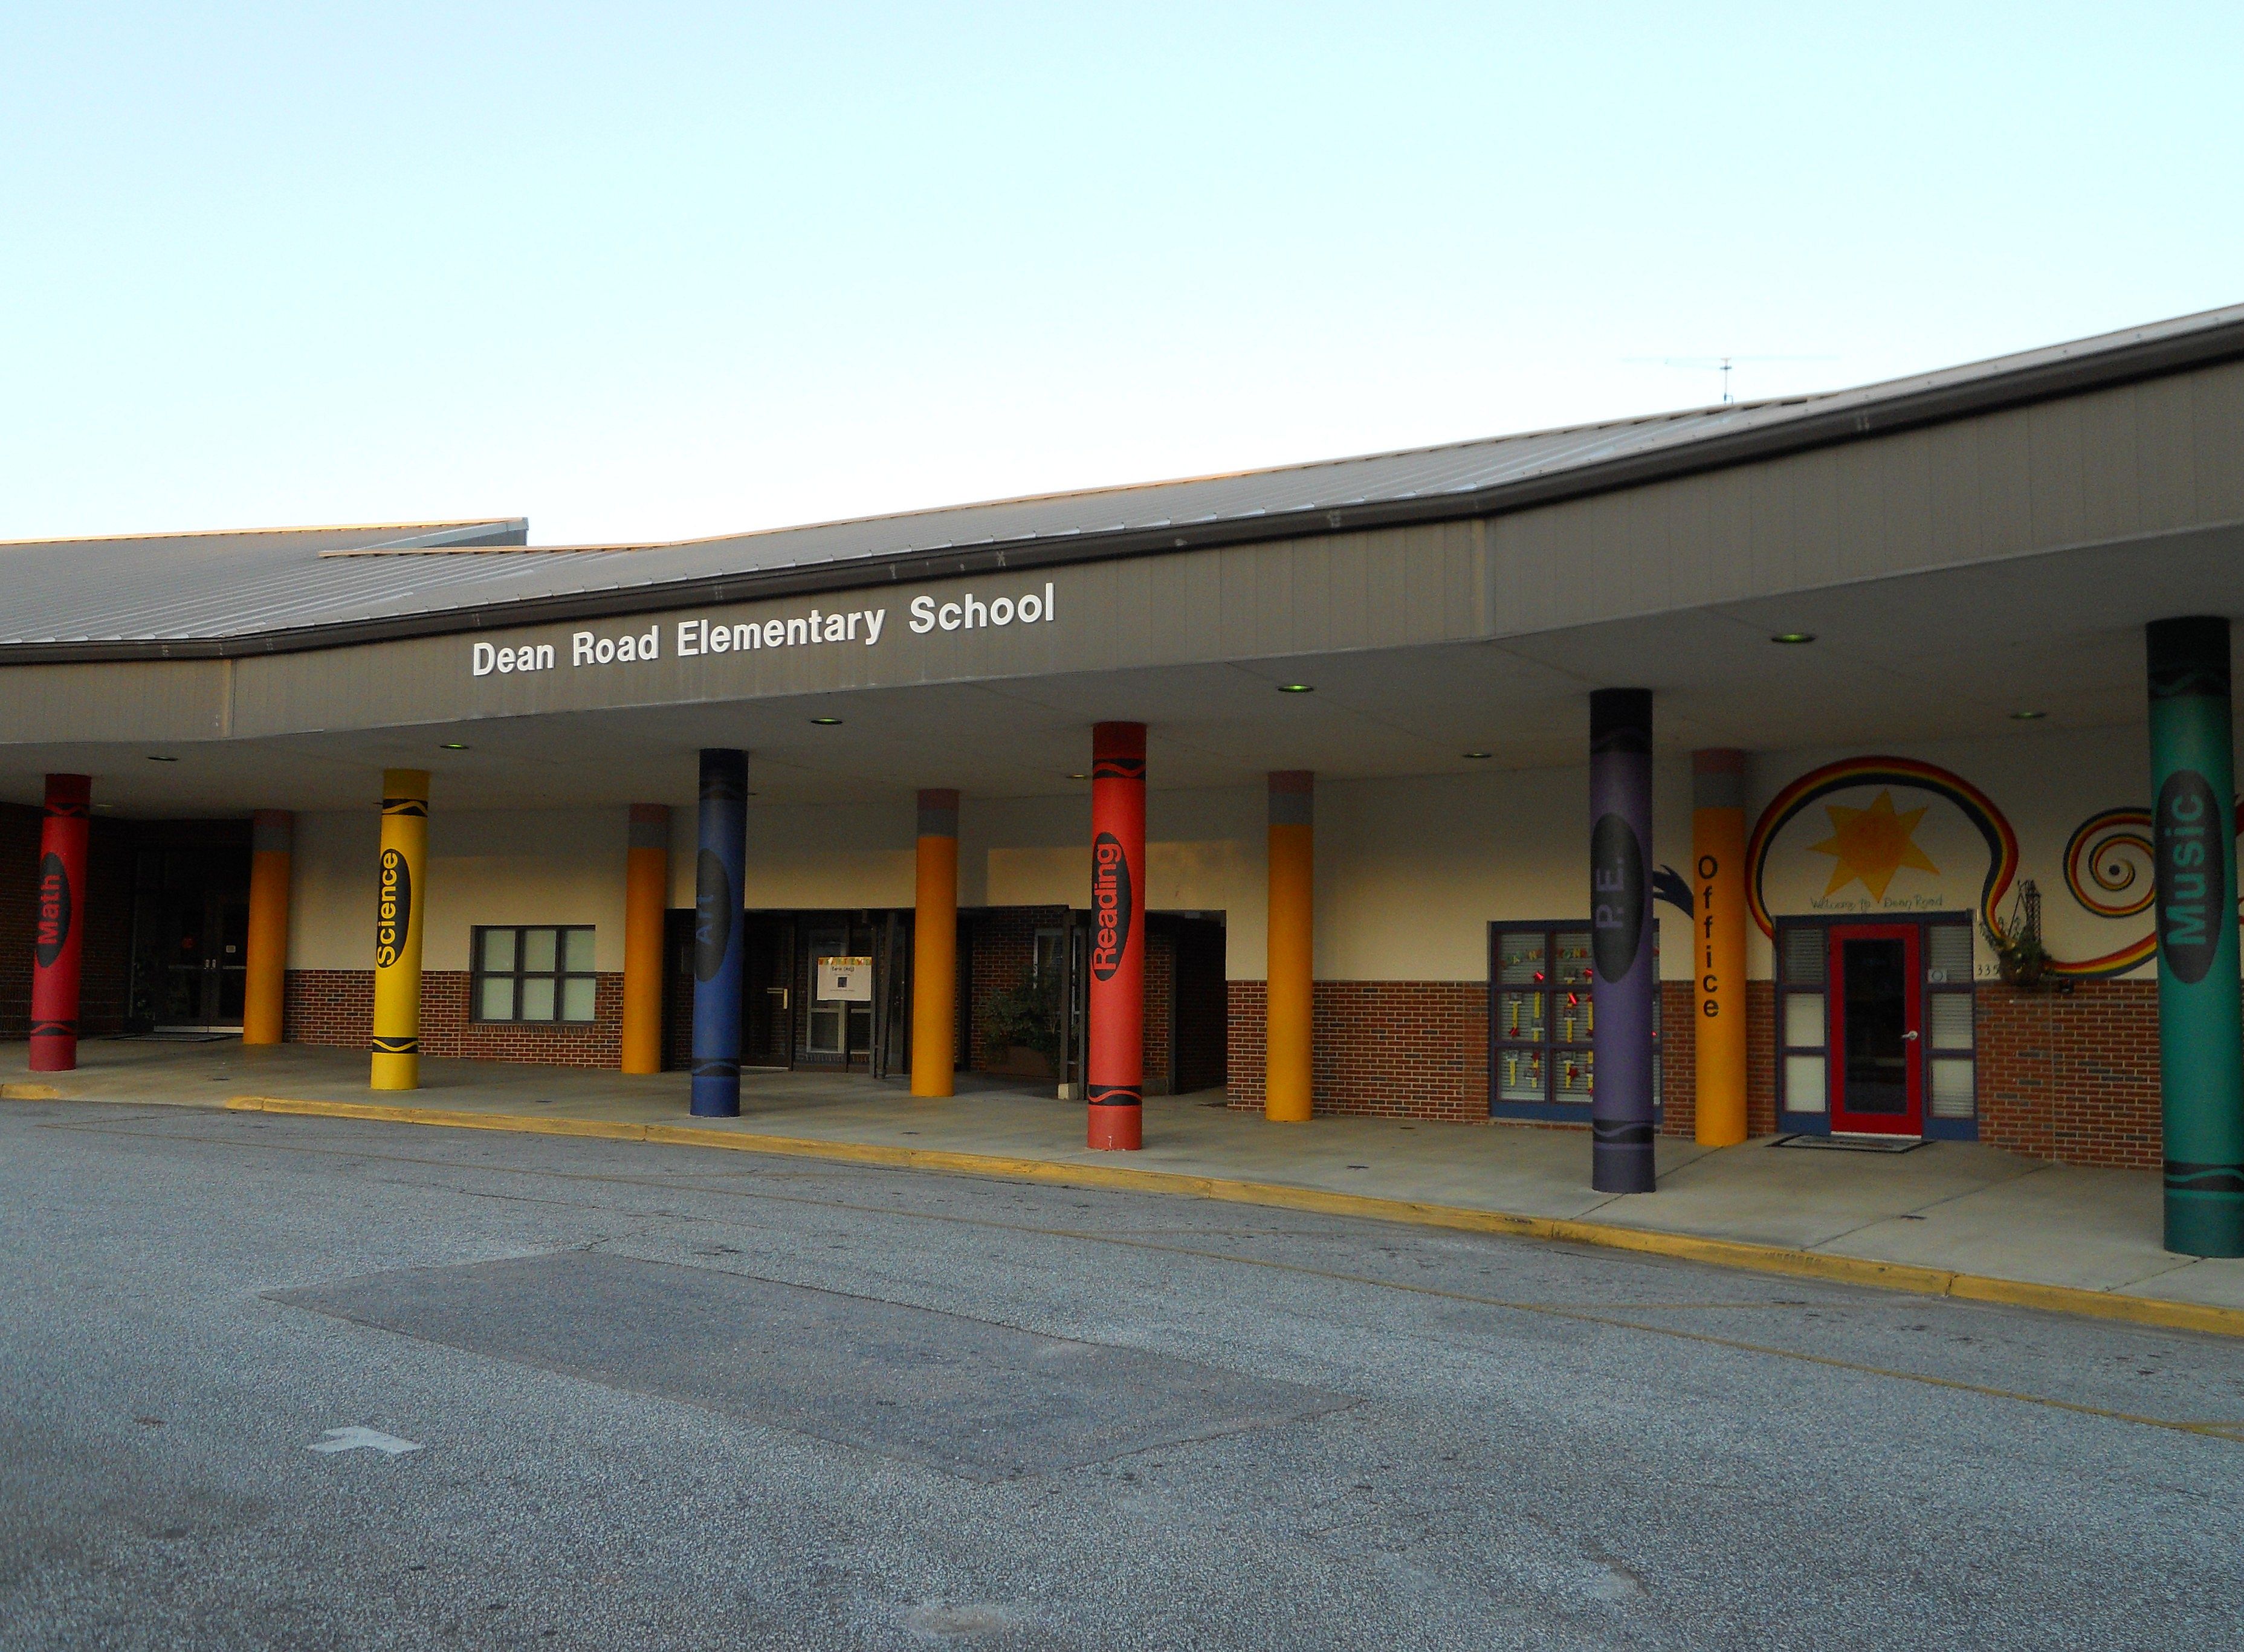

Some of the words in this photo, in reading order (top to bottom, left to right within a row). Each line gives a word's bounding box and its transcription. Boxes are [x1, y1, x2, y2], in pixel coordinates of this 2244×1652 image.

[473, 642, 555, 676] Dean
[573, 625, 659, 666] Road
[677, 608, 886, 657] Elementary
[909, 582, 1055, 634] School
[37, 874, 61, 944] Math
[377, 851, 398, 966] Science
[696, 894, 714, 945] Art
[1093, 843, 1122, 970] Reading
[1595, 857, 1625, 928] P.E.
[2165, 793, 2207, 946] Music
[1698, 854, 1719, 1018] Office
